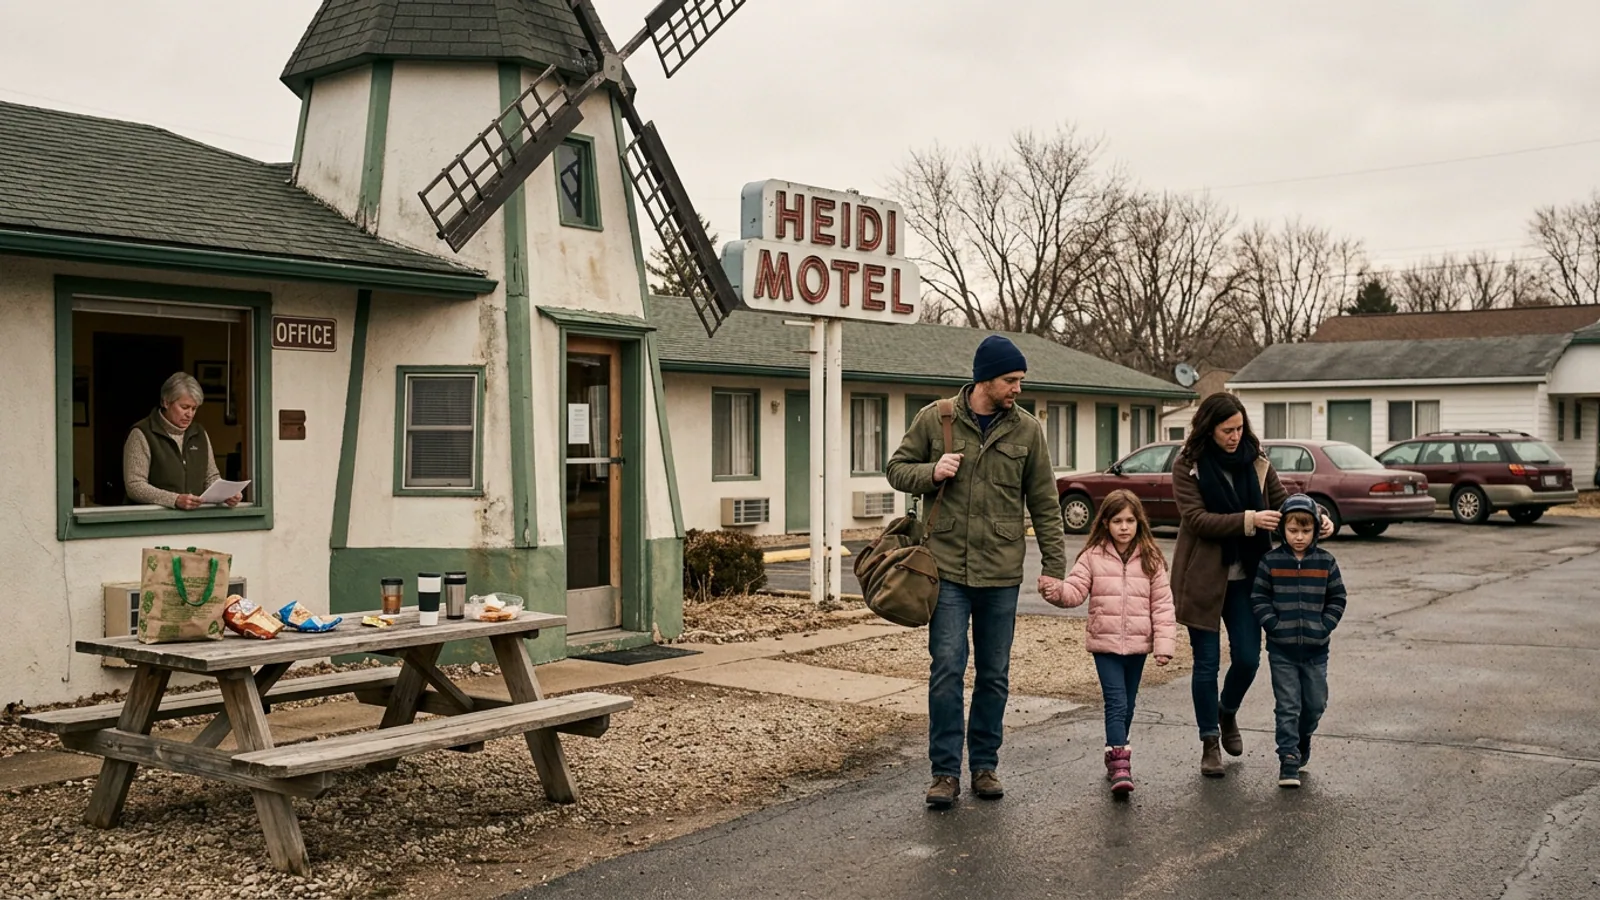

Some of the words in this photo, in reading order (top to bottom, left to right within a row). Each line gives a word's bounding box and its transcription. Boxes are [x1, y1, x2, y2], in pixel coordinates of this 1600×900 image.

[775, 190, 897, 255] HEIDI
[753, 249, 914, 314] MOTEL
[276, 322, 332, 345] OFFICE
